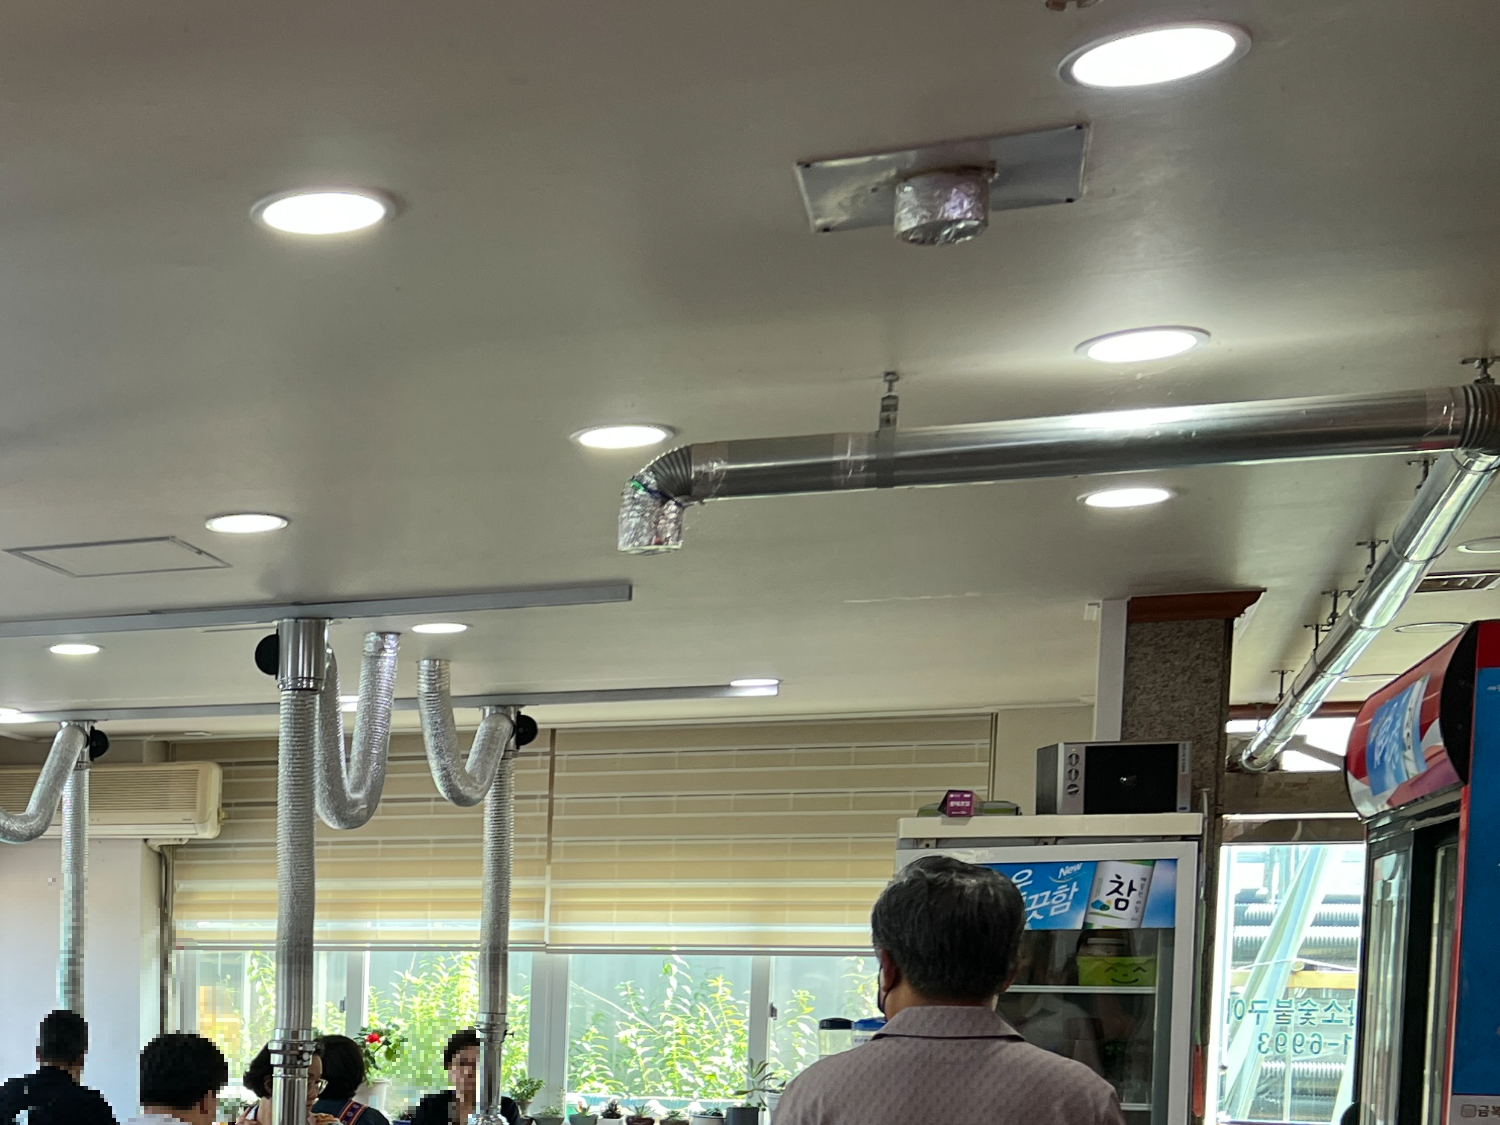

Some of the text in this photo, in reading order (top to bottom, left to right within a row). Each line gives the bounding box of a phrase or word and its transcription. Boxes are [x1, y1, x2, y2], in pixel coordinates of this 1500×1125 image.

[1058, 863, 1083, 879] New
[1022, 881, 1079, 922] 끗함
[1106, 873, 1137, 911] 참
